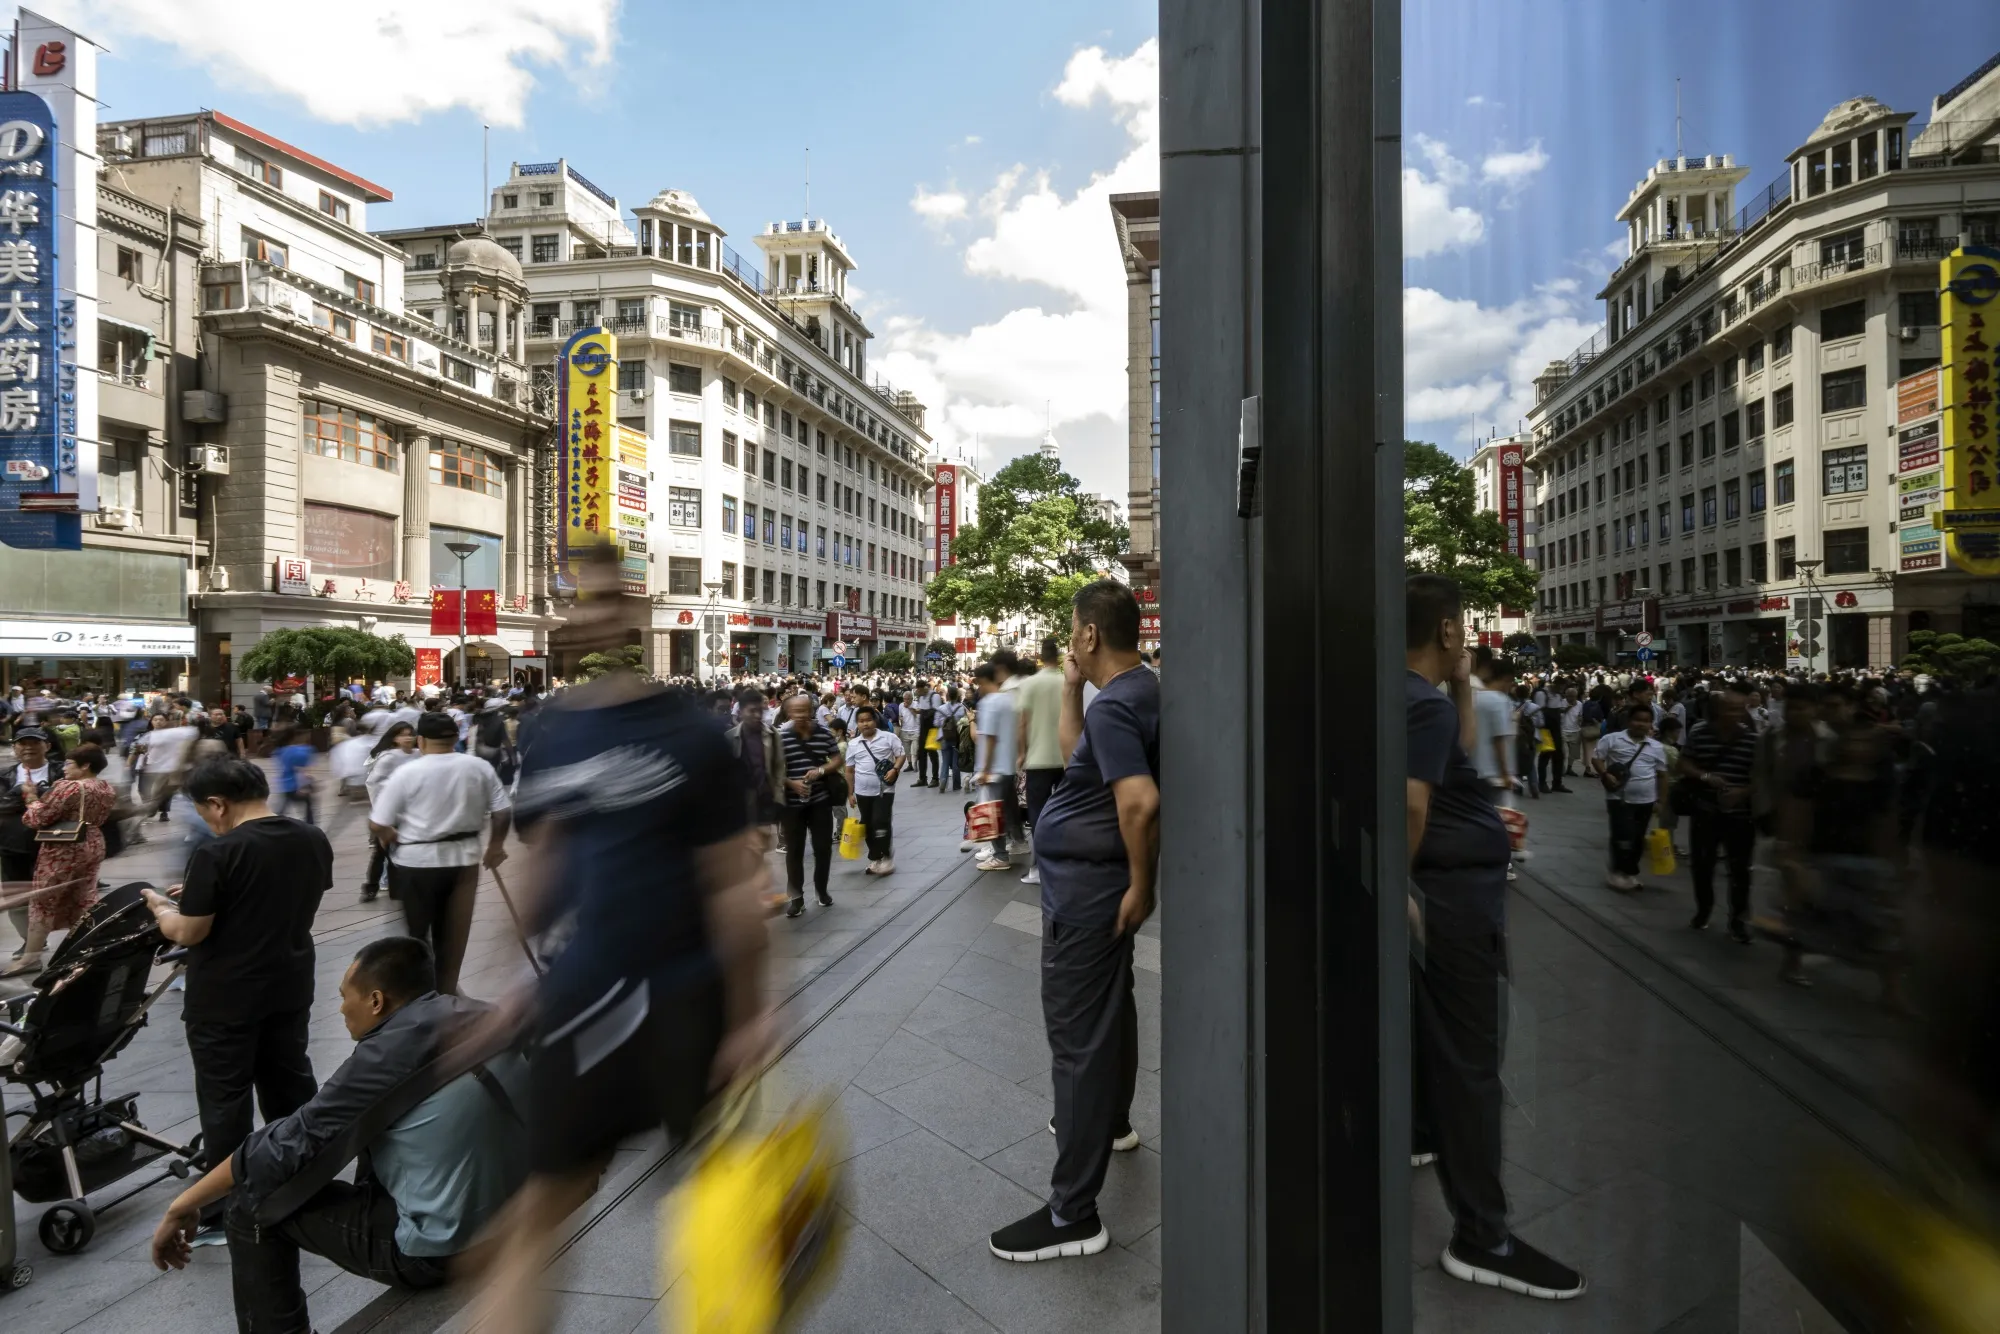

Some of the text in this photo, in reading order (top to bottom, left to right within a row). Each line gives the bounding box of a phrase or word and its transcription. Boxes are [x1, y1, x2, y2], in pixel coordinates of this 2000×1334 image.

[0, 189, 40, 432] 华美大药房
[59, 363, 77, 478] Pharmacy
